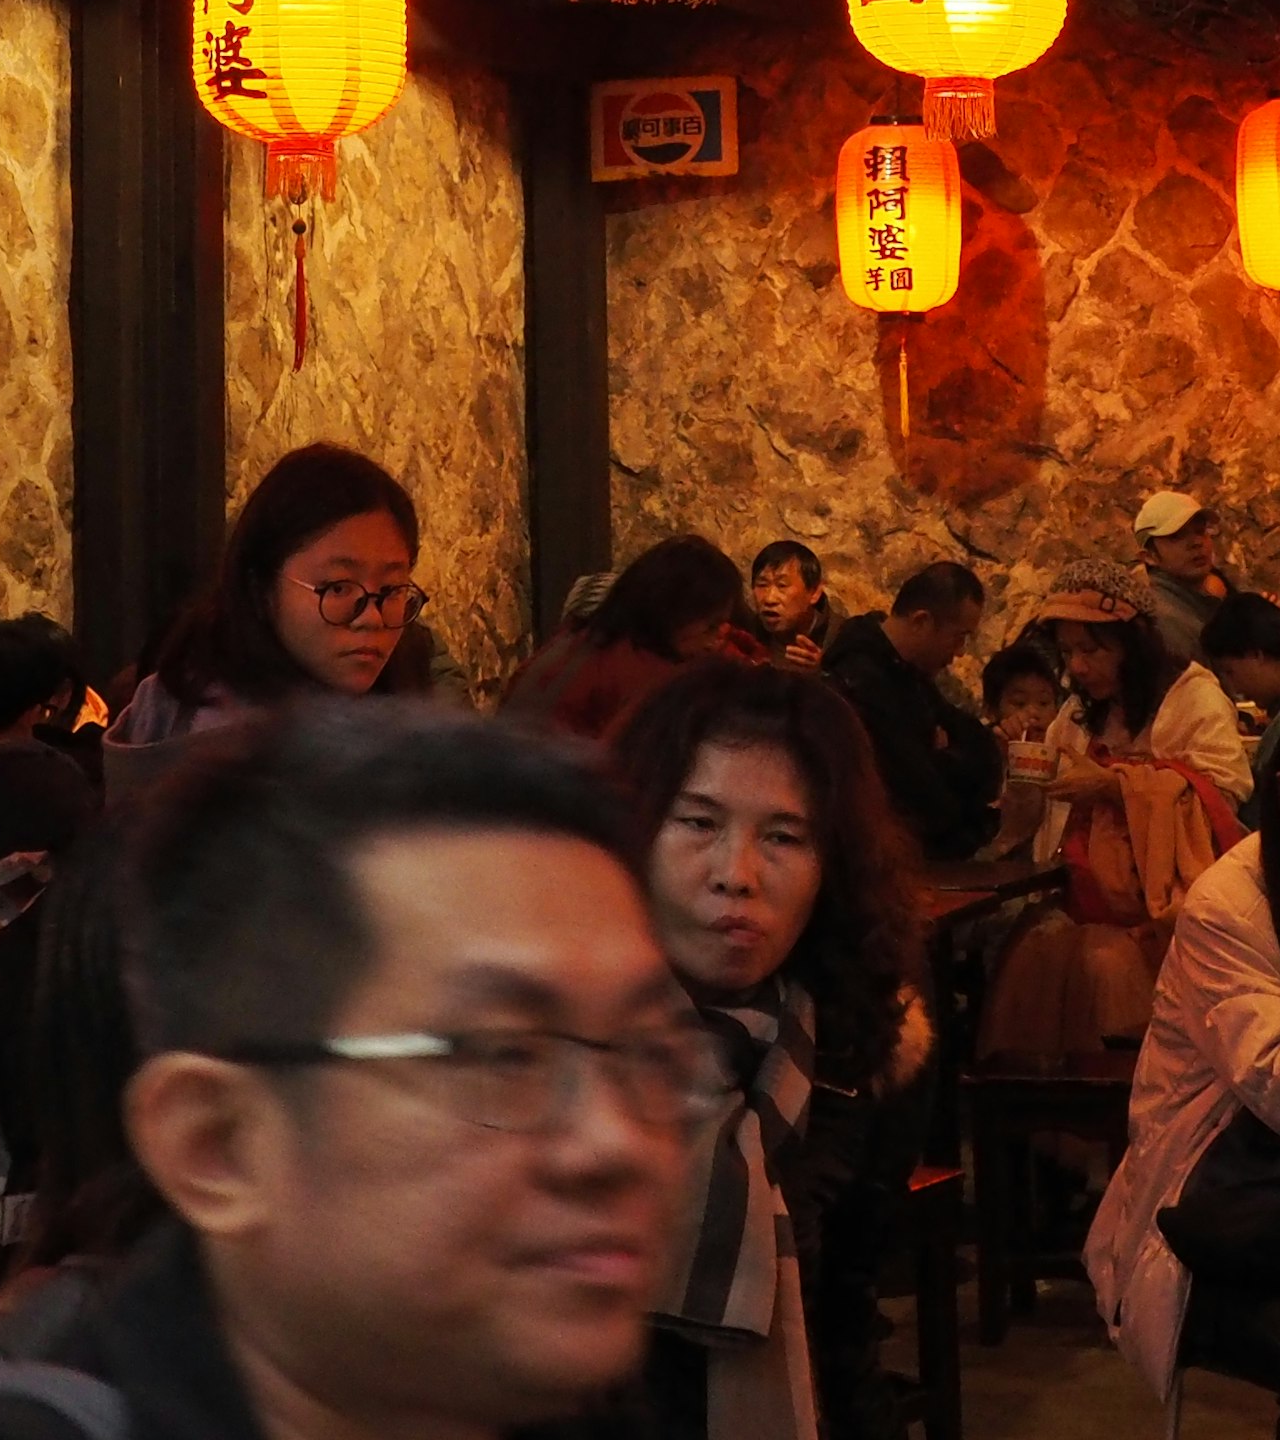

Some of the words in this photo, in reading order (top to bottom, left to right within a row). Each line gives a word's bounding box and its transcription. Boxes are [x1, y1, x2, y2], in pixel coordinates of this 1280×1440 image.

[864, 145, 910, 262] 賴阿婆
[866, 266, 914, 292] 芋圓
